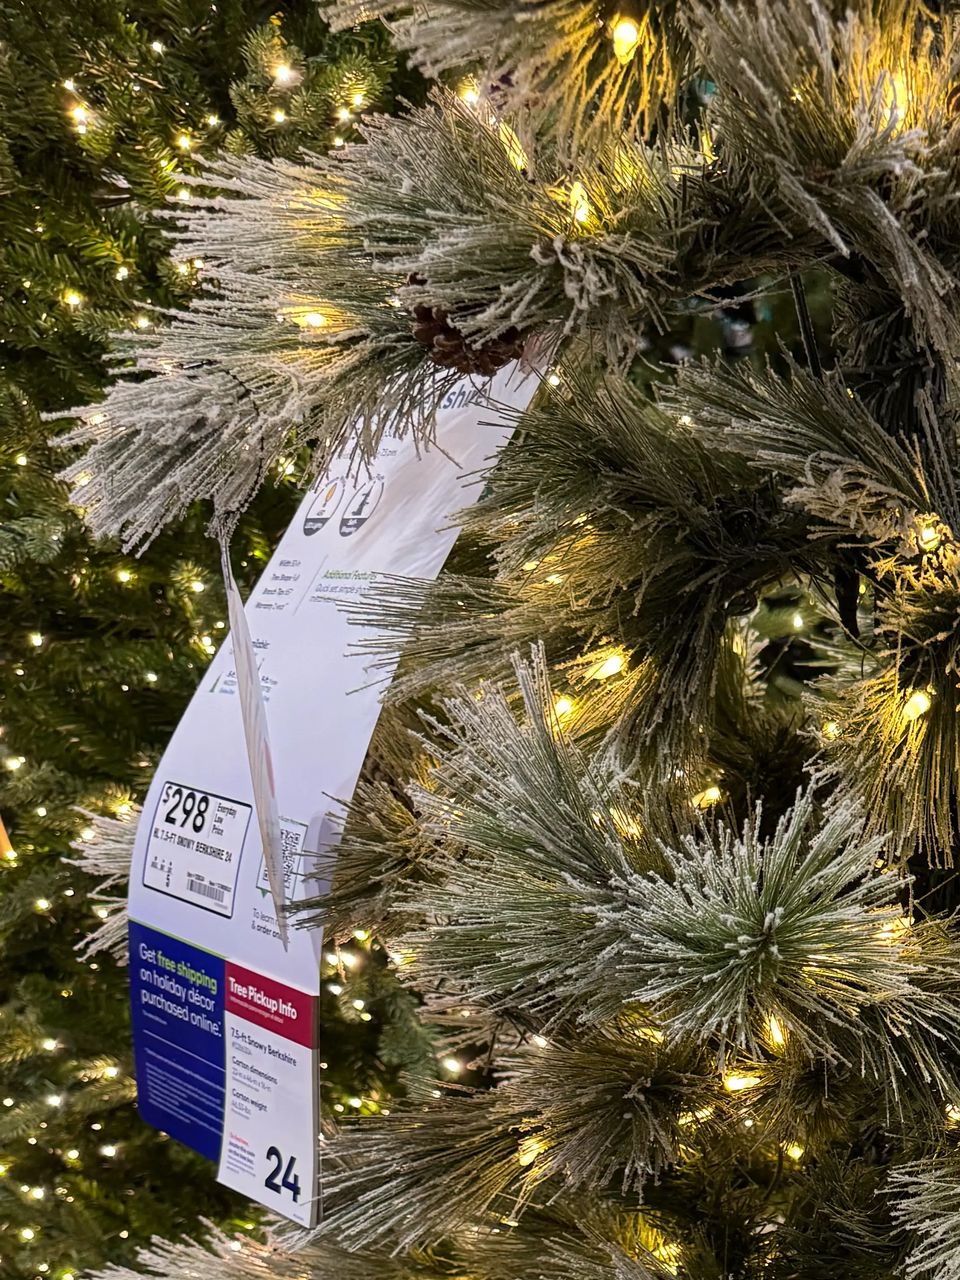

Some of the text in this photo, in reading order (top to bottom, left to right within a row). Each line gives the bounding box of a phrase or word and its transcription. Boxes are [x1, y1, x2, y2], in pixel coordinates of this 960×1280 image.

[163, 785, 209, 833] $298
[214, 814, 224, 824] Low
[217, 802, 237, 819] Everyday
[211, 825, 225, 837] Price
[177, 835, 196, 851] SNOWY
[195, 842, 225, 861] BERKSHIRE
[225, 851, 233, 863] 24
[139, 943, 218, 995] Get free shipping
[140, 968, 152, 983] on
[153, 970, 187, 1002] holiday
[188, 987, 215, 1012] décor
[141, 989, 189, 1021] purchased
[228, 976, 247, 998] Tree
[248, 985, 278, 1013] Pickup
[279, 998, 298, 1020] Info
[232, 1055, 249, 1072] Carton
[247, 1035, 267, 1054] Snowy
[267, 1044, 297, 1067] Berkshire
[232, 1088, 250, 1104] Carton
[265, 1145, 301, 1204] 24
